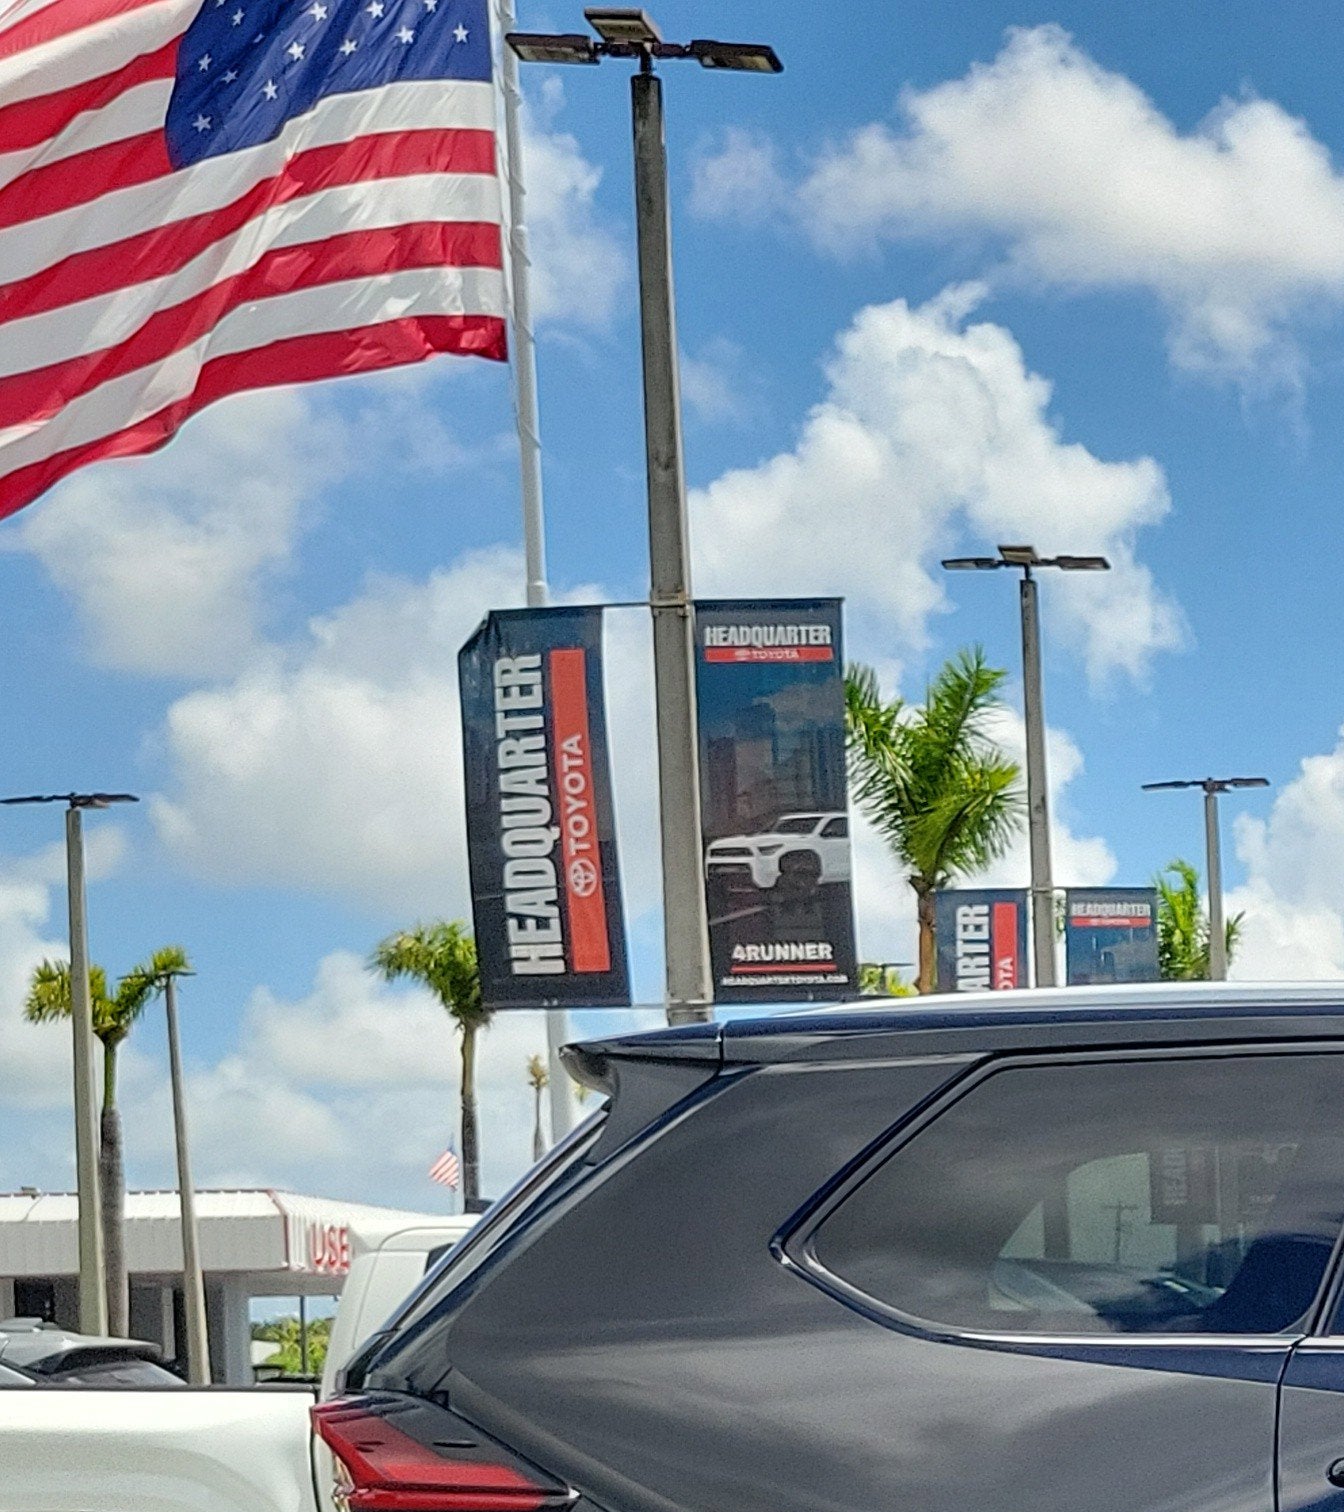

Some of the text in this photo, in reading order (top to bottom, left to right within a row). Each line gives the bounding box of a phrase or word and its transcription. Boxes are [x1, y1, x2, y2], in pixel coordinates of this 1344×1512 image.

[704, 625, 831, 648] HEADQUARTER
[495, 652, 566, 975] HEADQUARTER
[561, 734, 597, 856] TOYOTA
[731, 942, 833, 961] 4RUNNER
